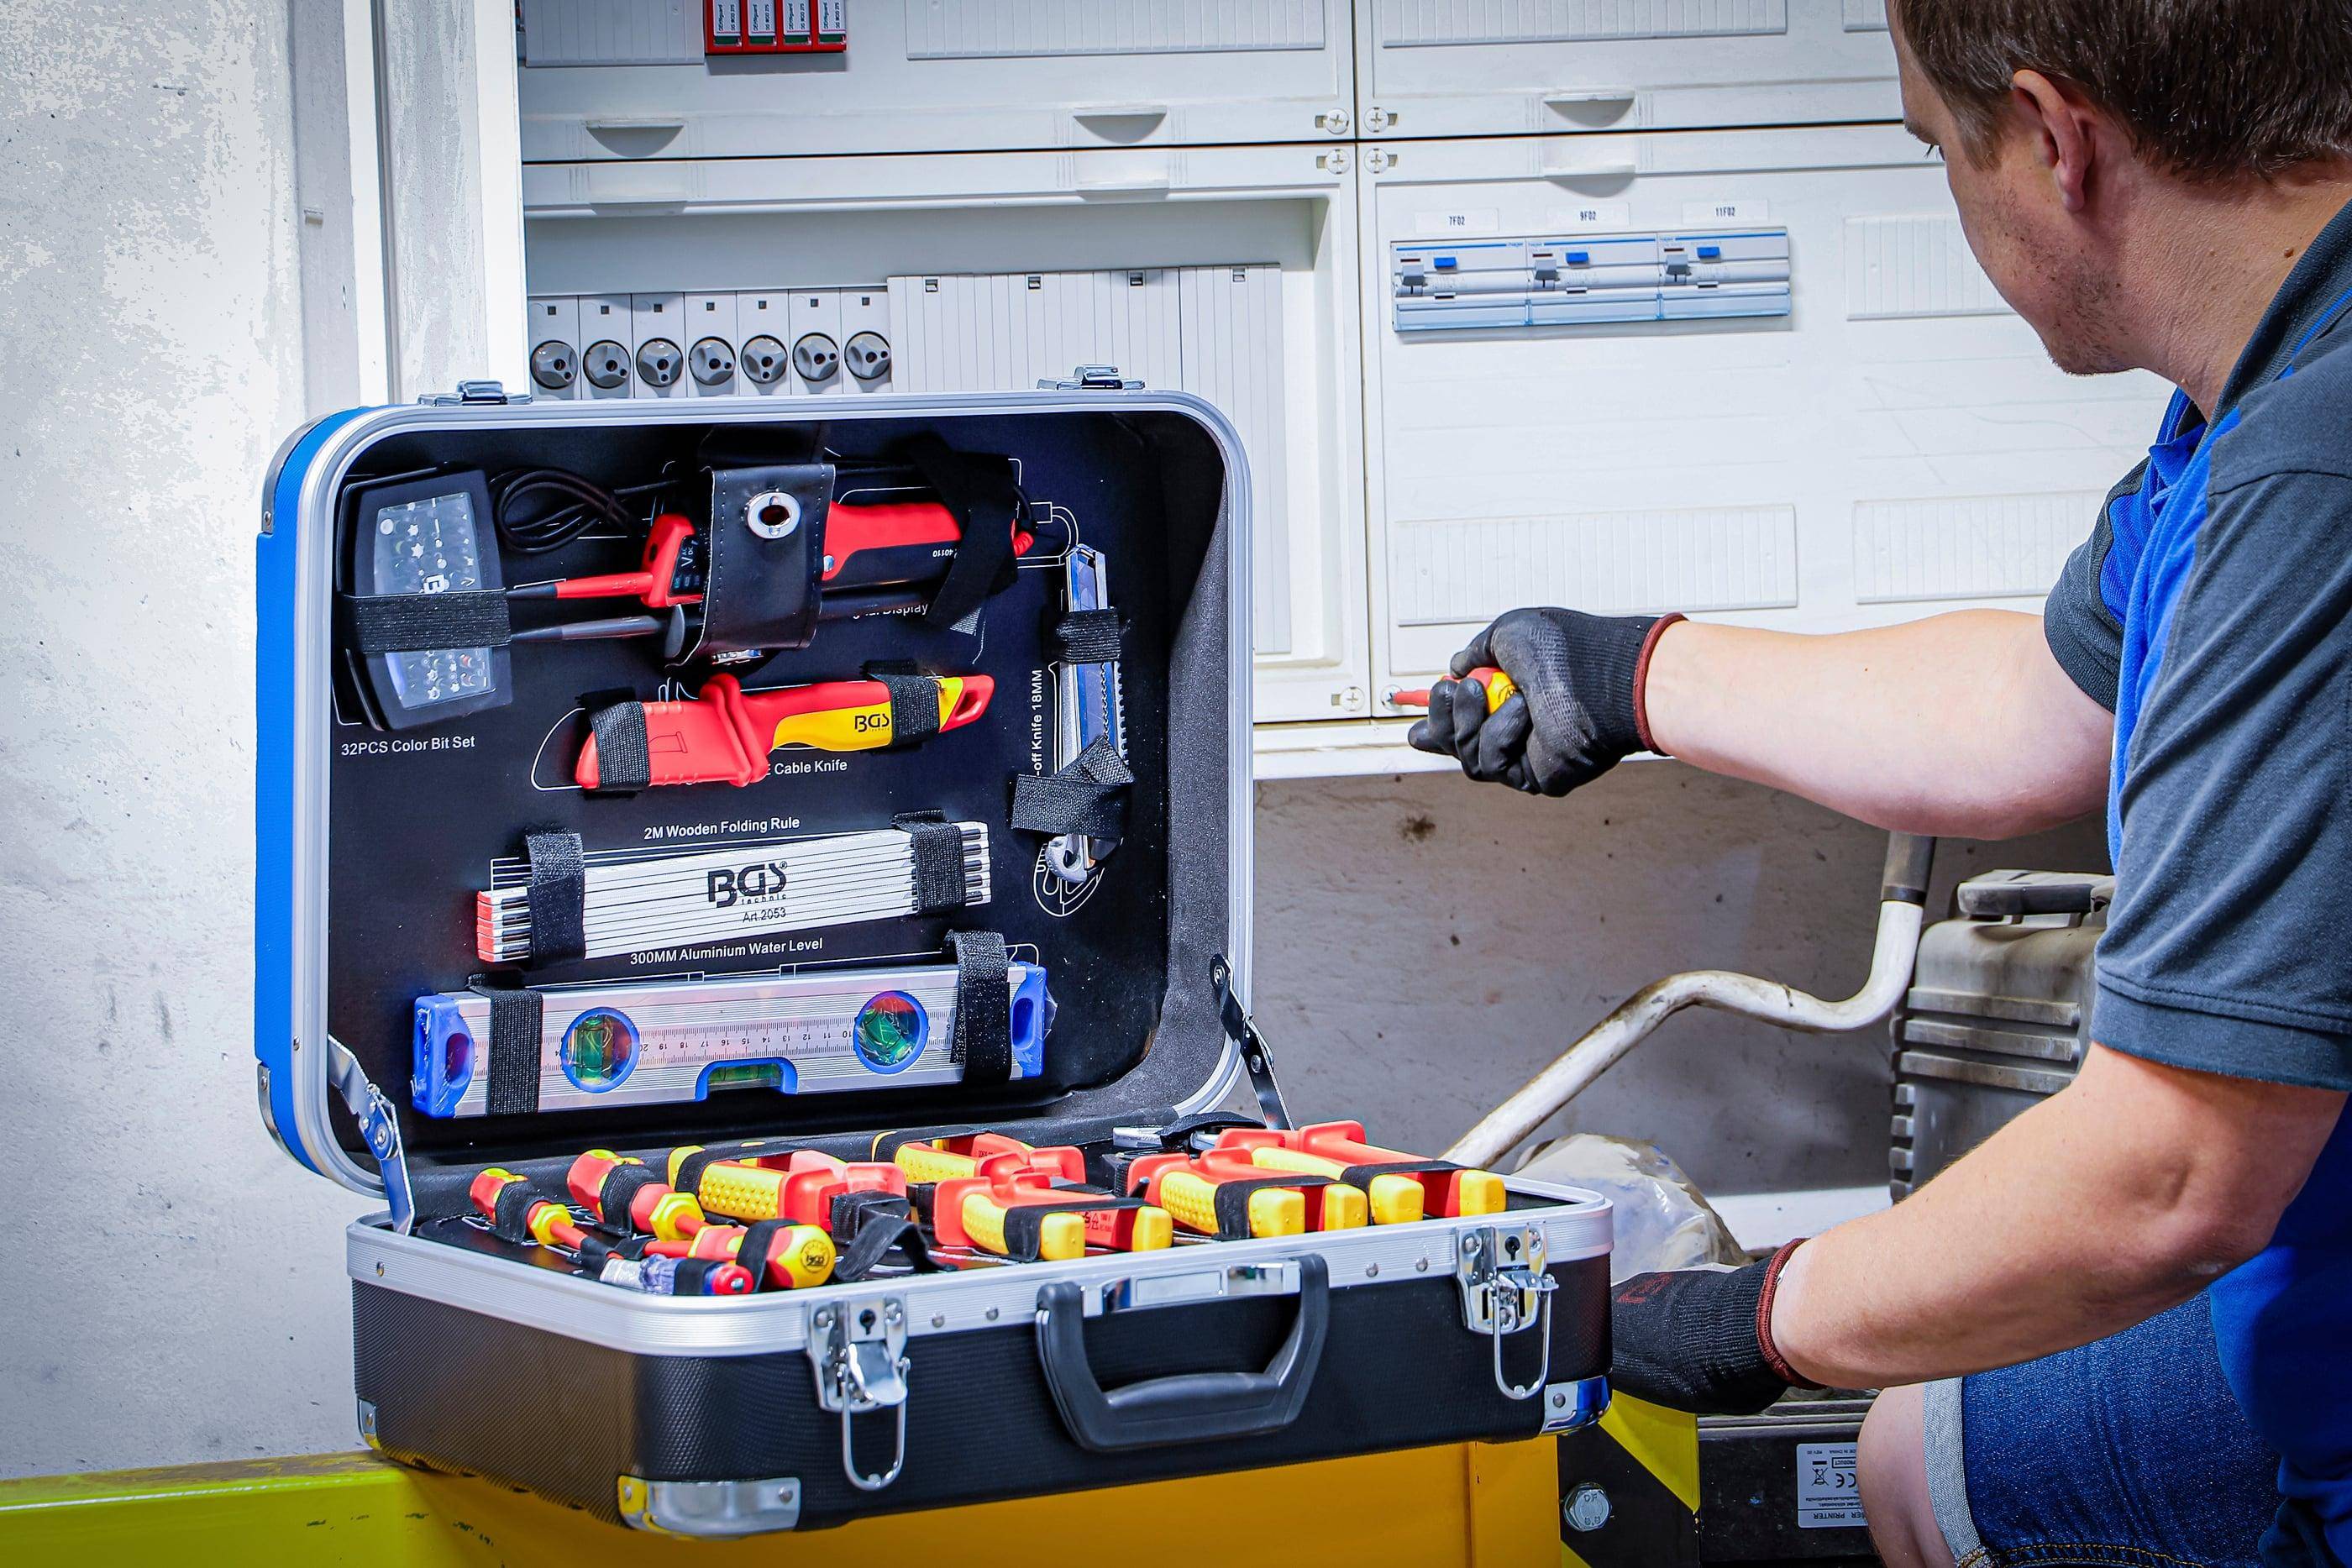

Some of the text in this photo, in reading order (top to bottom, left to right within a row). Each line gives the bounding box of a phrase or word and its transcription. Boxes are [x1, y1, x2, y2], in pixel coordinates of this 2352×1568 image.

[1449, 215, 1466, 226] 7F02
[1580, 210, 1597, 221] 9F02
[1715, 207, 1735, 217] 11F02
[932, 548, 953, 558] 40110
[1032, 669, 1042, 711] 18MM
[854, 713, 890, 732] BGS
[1032, 715, 1042, 750] Knife
[341, 736, 476, 756] 32PCS Color Bit Set
[774, 762, 811, 775] Cable
[815, 759, 848, 773] Knife
[643, 816, 800, 840] 2M Wooden Folding Rule
[708, 863, 787, 908] BGS
[630, 937, 823, 965] 300MM Aluminium Water Level
[842, 1030, 852, 1039] 10
